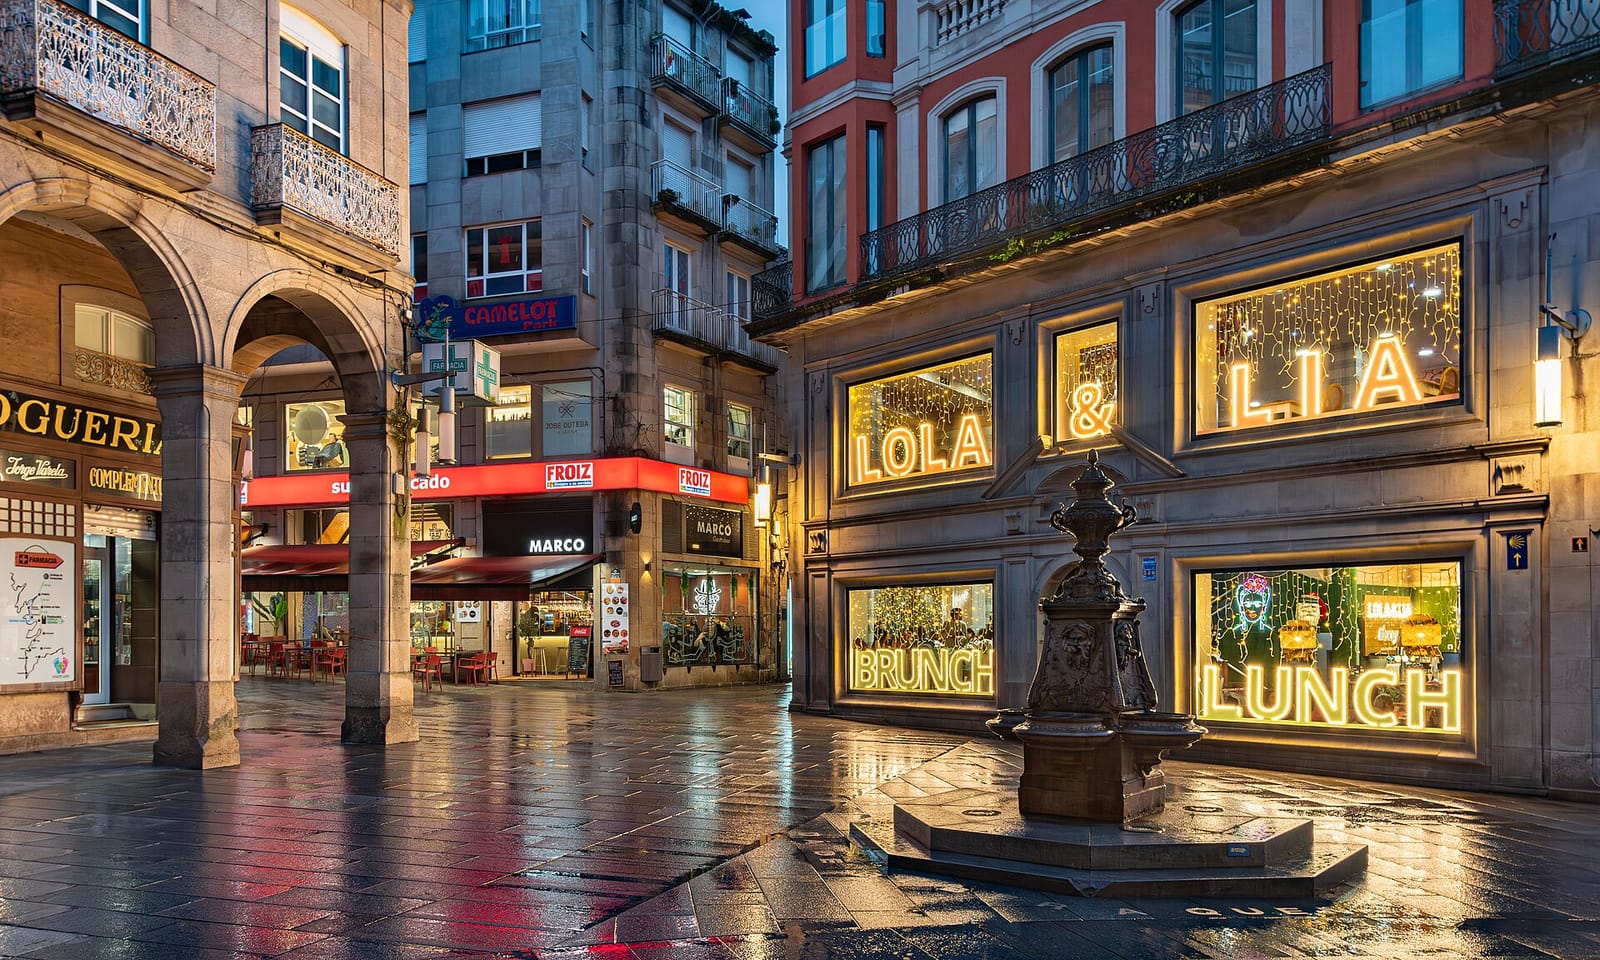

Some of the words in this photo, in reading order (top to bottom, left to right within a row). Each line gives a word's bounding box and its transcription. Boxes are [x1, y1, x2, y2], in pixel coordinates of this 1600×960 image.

[464, 300, 558, 326] CAMELOT
[522, 319, 558, 331] Park
[432, 361, 465, 371] FARACIA
[856, 415, 991, 483] LOLA
[1069, 383, 1115, 439] &
[1231, 335, 1423, 428] LIA
[547, 464, 591, 481] FROIZ
[680, 469, 709, 488] FROIZ
[697, 521, 732, 537] MARCO
[529, 538, 585, 553] MARCO
[854, 648, 994, 694] BRUNCH
[1201, 664, 1462, 732] LUNCH
